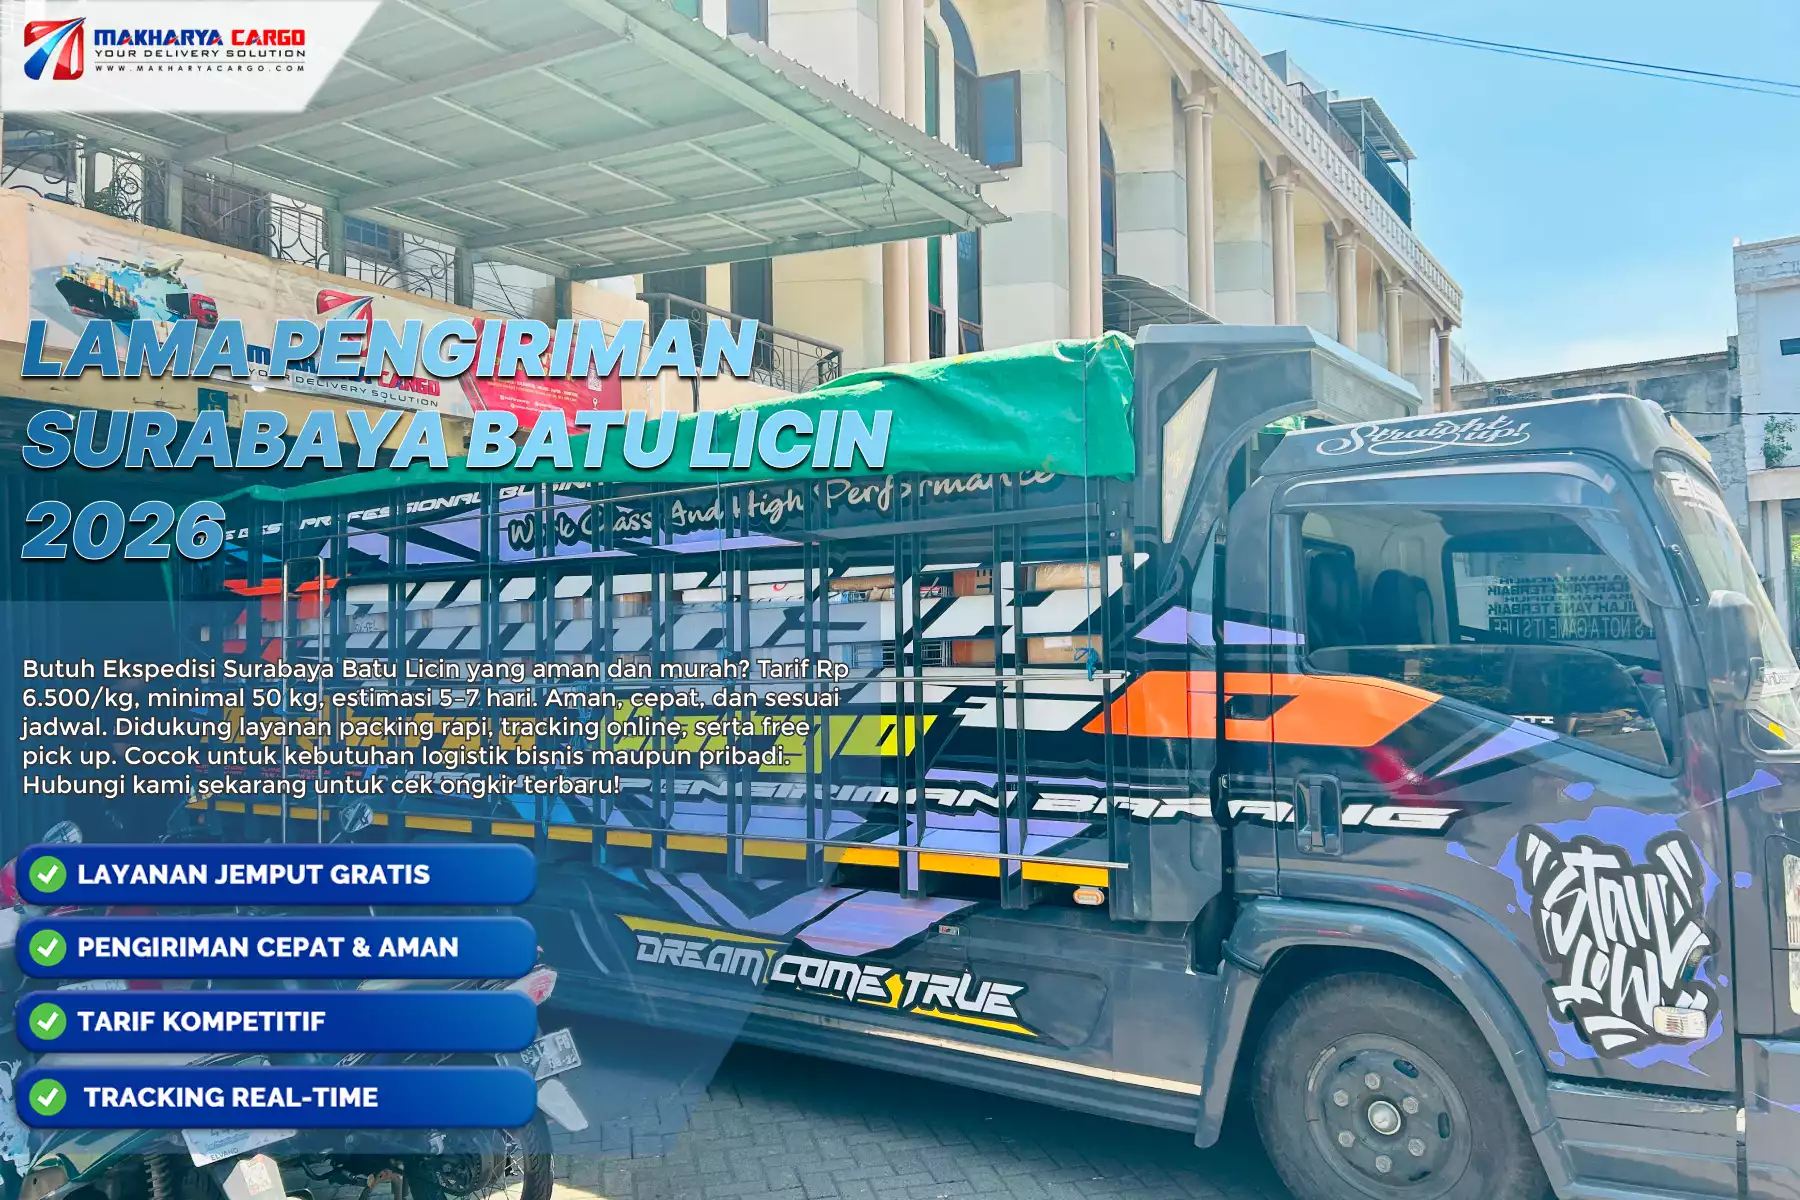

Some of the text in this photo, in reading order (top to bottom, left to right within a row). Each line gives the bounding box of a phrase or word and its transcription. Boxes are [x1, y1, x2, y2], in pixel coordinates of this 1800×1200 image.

[249, 367, 439, 407] YOR DELIVERY SOLUTION
[1316, 414, 1513, 456] Straight
[1032, 792, 1463, 830] BARAG
[636, 934, 1025, 1018] DREAM COME TRUE
